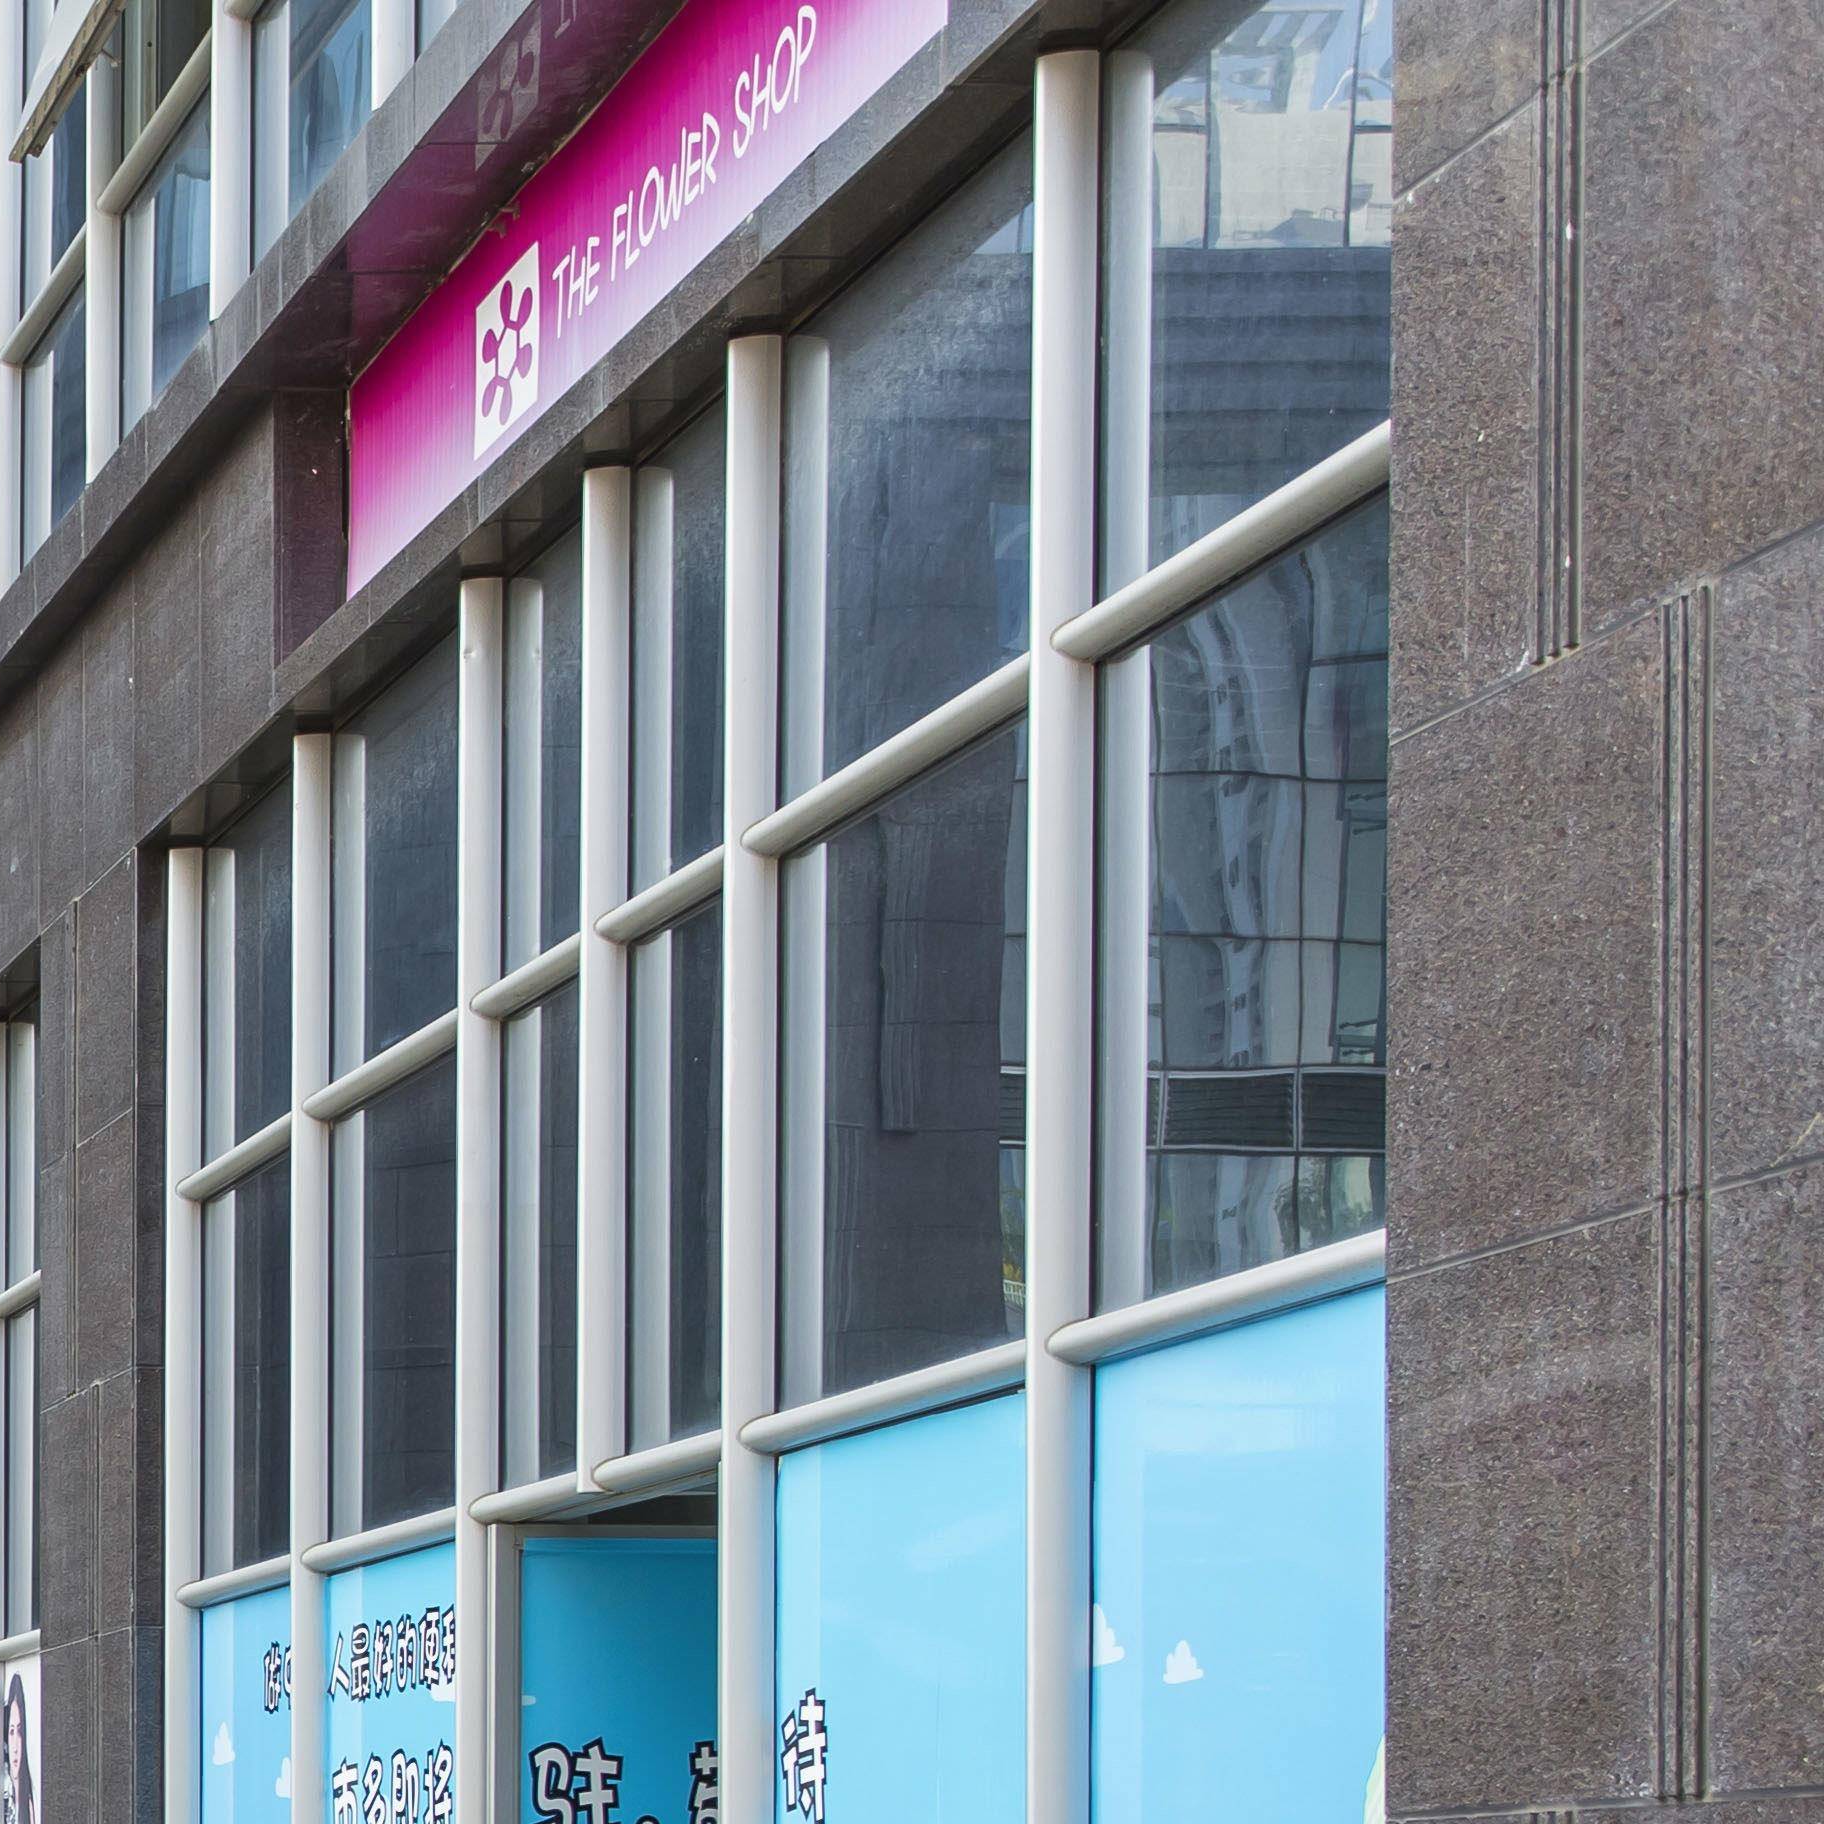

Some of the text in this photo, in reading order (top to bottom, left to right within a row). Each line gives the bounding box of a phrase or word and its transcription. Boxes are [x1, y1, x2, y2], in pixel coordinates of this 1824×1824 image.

[552, 4, 816, 339] THE FLOWER SHOP
